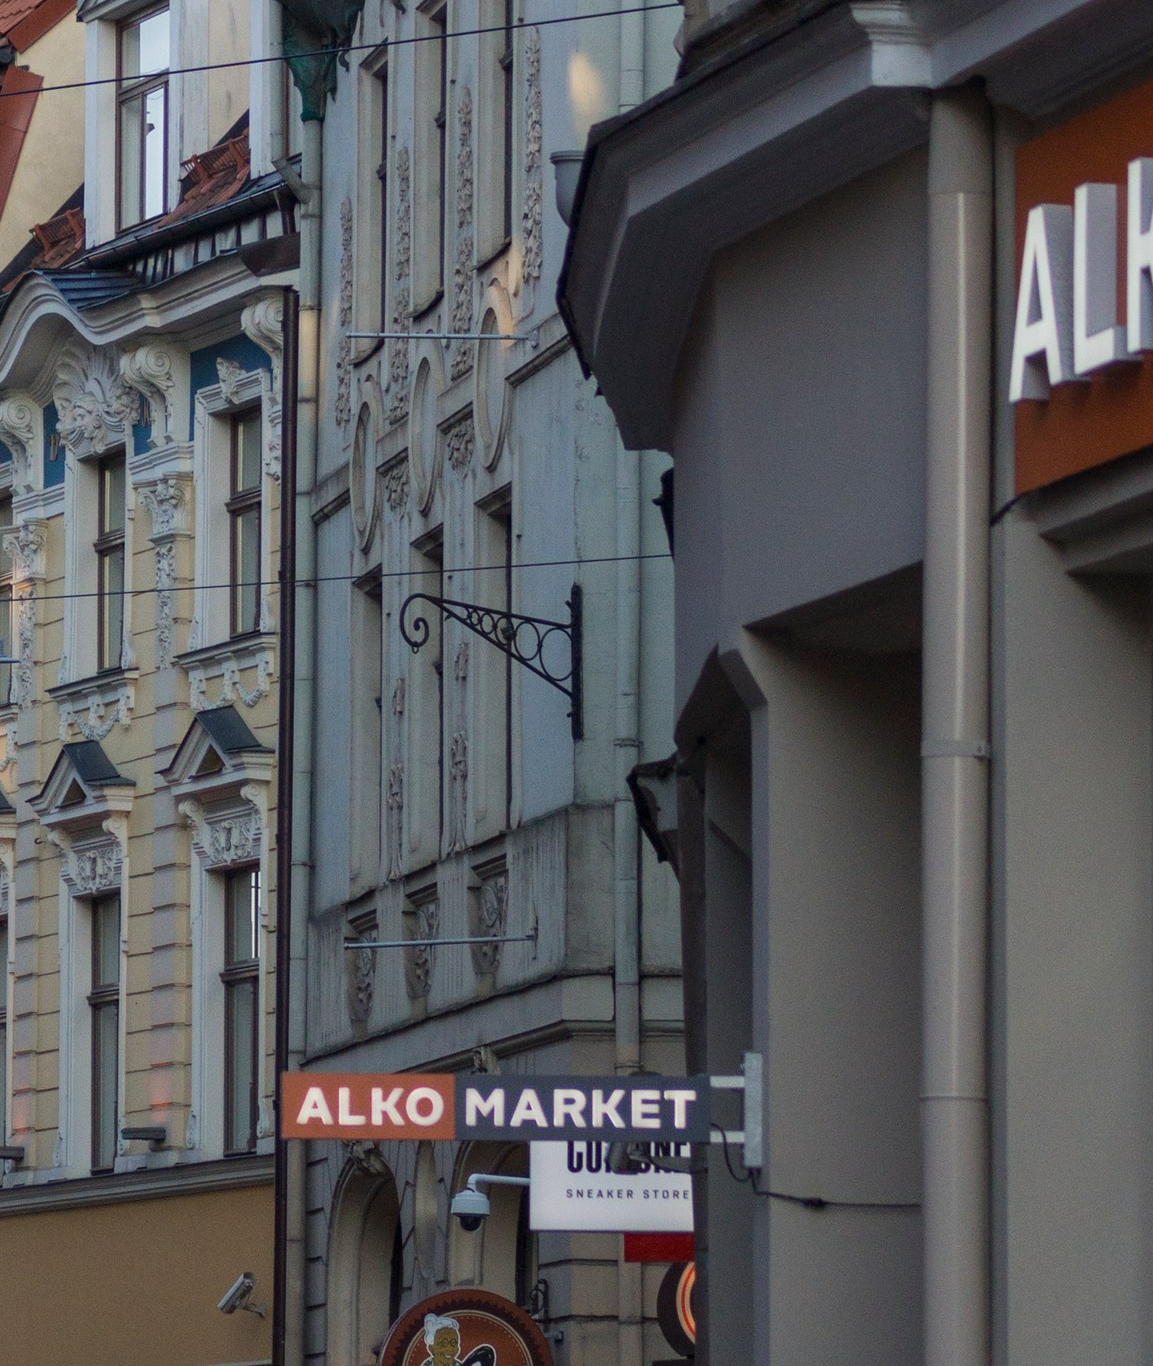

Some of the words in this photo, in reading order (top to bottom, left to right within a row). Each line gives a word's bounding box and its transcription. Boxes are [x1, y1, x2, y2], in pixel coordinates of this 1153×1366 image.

[295, 1086, 445, 1127] ALKO
[464, 1087, 698, 1130] MARKET
[566, 1189, 634, 1199] SNEAKER
[643, 1189, 690, 1199] STORE
